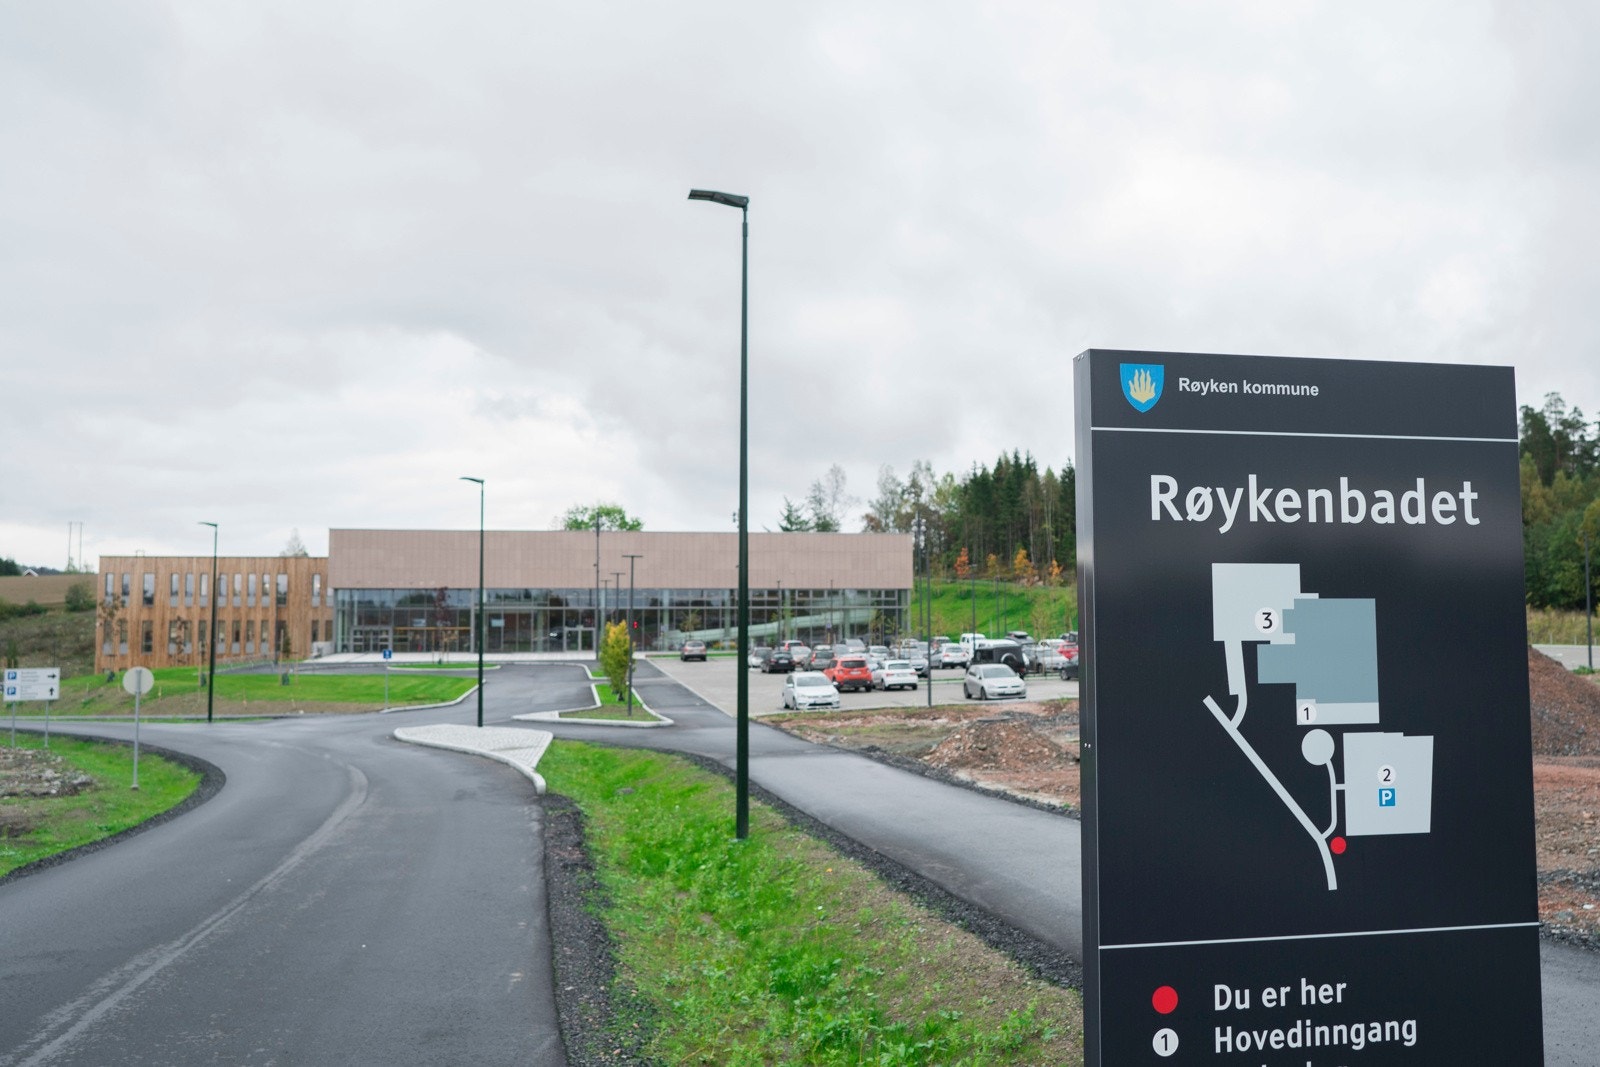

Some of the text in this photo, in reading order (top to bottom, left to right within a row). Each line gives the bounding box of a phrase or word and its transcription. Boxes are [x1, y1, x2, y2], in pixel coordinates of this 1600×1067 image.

[1178, 377, 1319, 397] Røyken kommune
[1150, 473, 1481, 535] Røykenbadet
[1262, 611, 1273, 630] 3
[1382, 768, 1391, 783] 2
[1381, 789, 1393, 805] P
[1214, 977, 1347, 1011] Du er her
[1214, 1019, 1417, 1054] Hovedinngang
